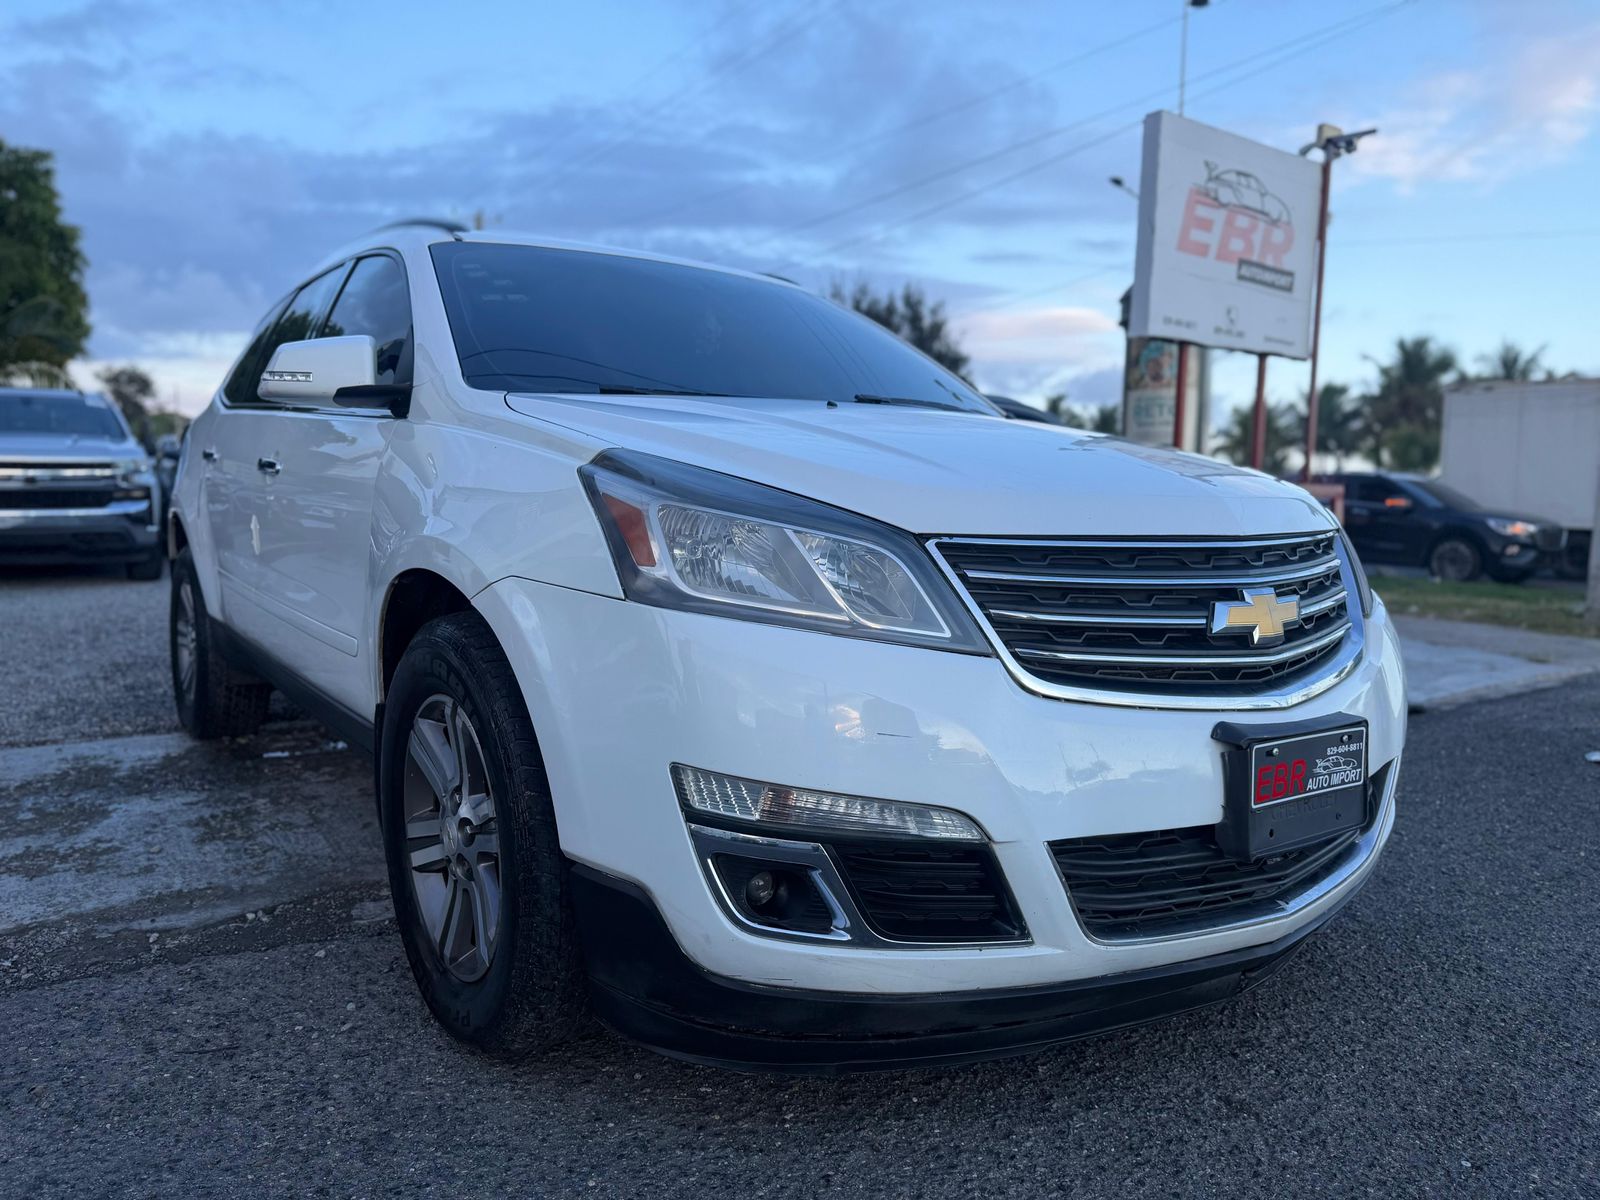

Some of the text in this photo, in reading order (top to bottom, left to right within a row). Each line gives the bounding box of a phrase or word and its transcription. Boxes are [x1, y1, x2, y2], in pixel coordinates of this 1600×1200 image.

[1177, 187, 1295, 269] EBR
[1326, 742, 1363, 755] 829-604-8811
[1255, 758, 1307, 803] EBR
[1306, 768, 1361, 792] AUTO IMPORT
